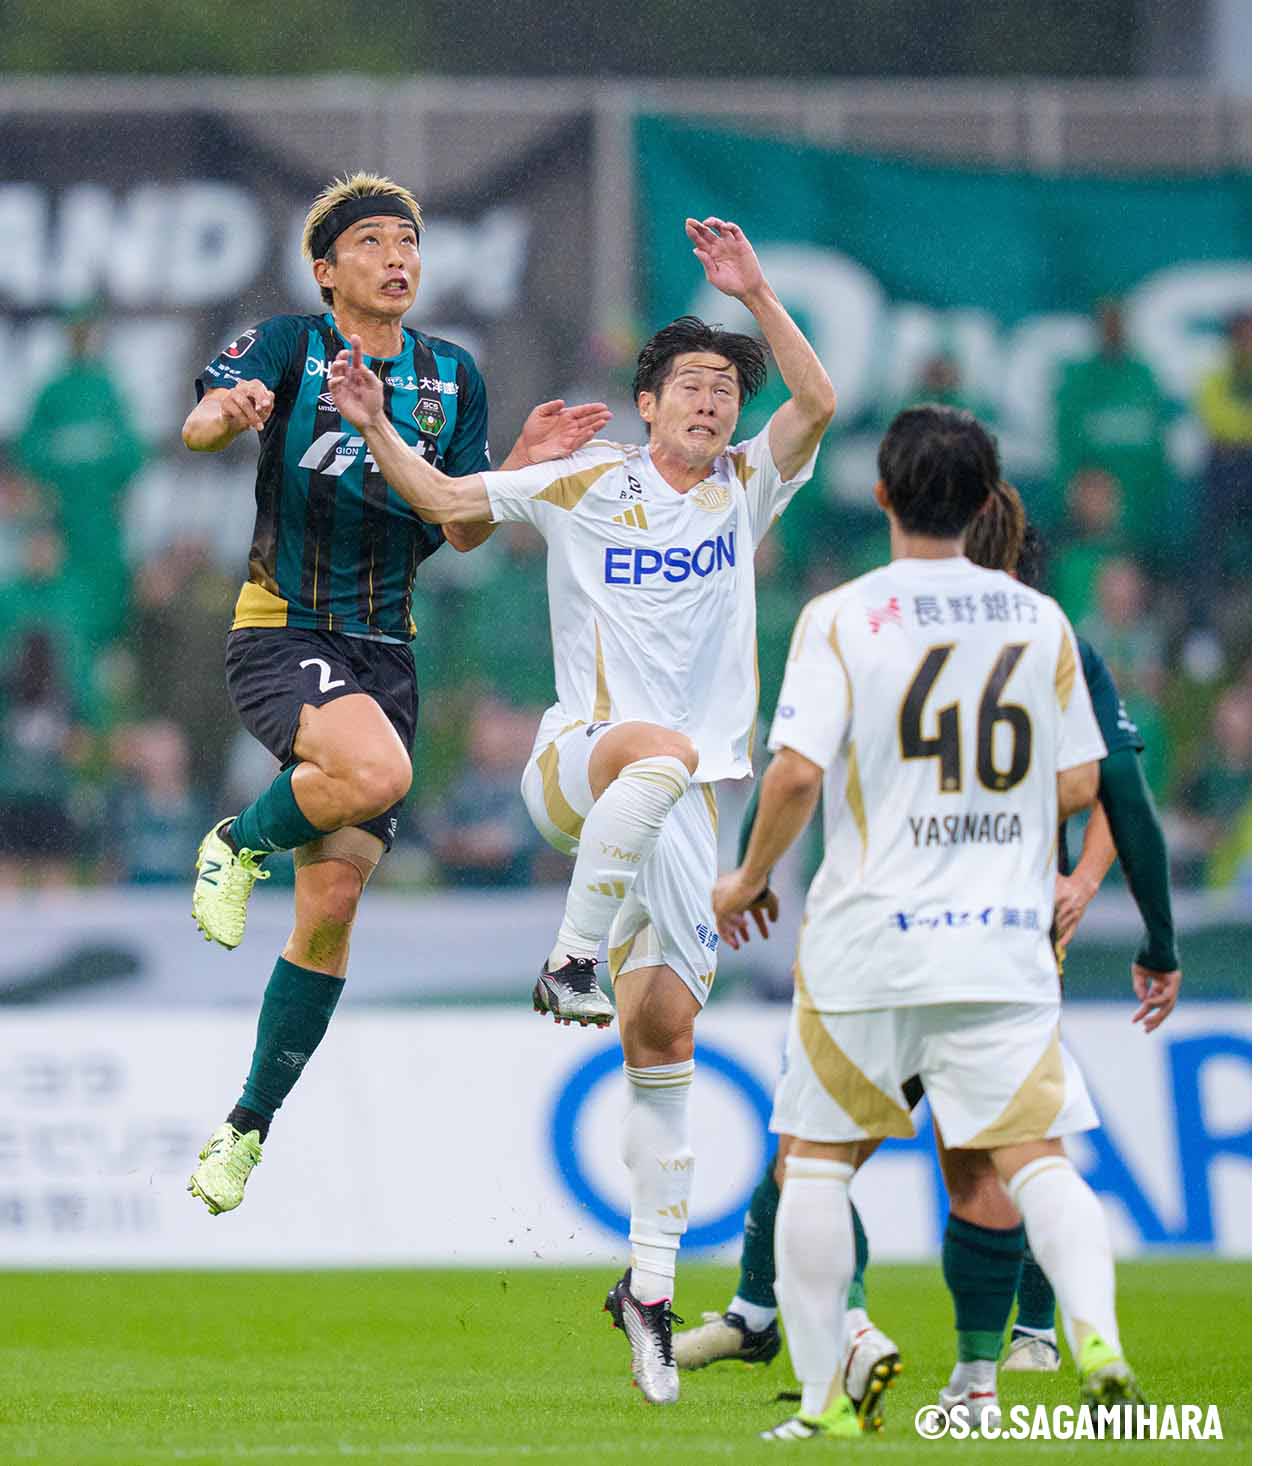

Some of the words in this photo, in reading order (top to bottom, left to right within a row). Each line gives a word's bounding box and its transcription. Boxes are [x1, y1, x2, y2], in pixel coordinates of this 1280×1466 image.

[336, 447, 359, 456] GION
[605, 531, 736, 585] EPSON
[912, 593, 1038, 626] 長野銀行
[300, 658, 346, 694] 2
[897, 640, 1034, 794] 46
